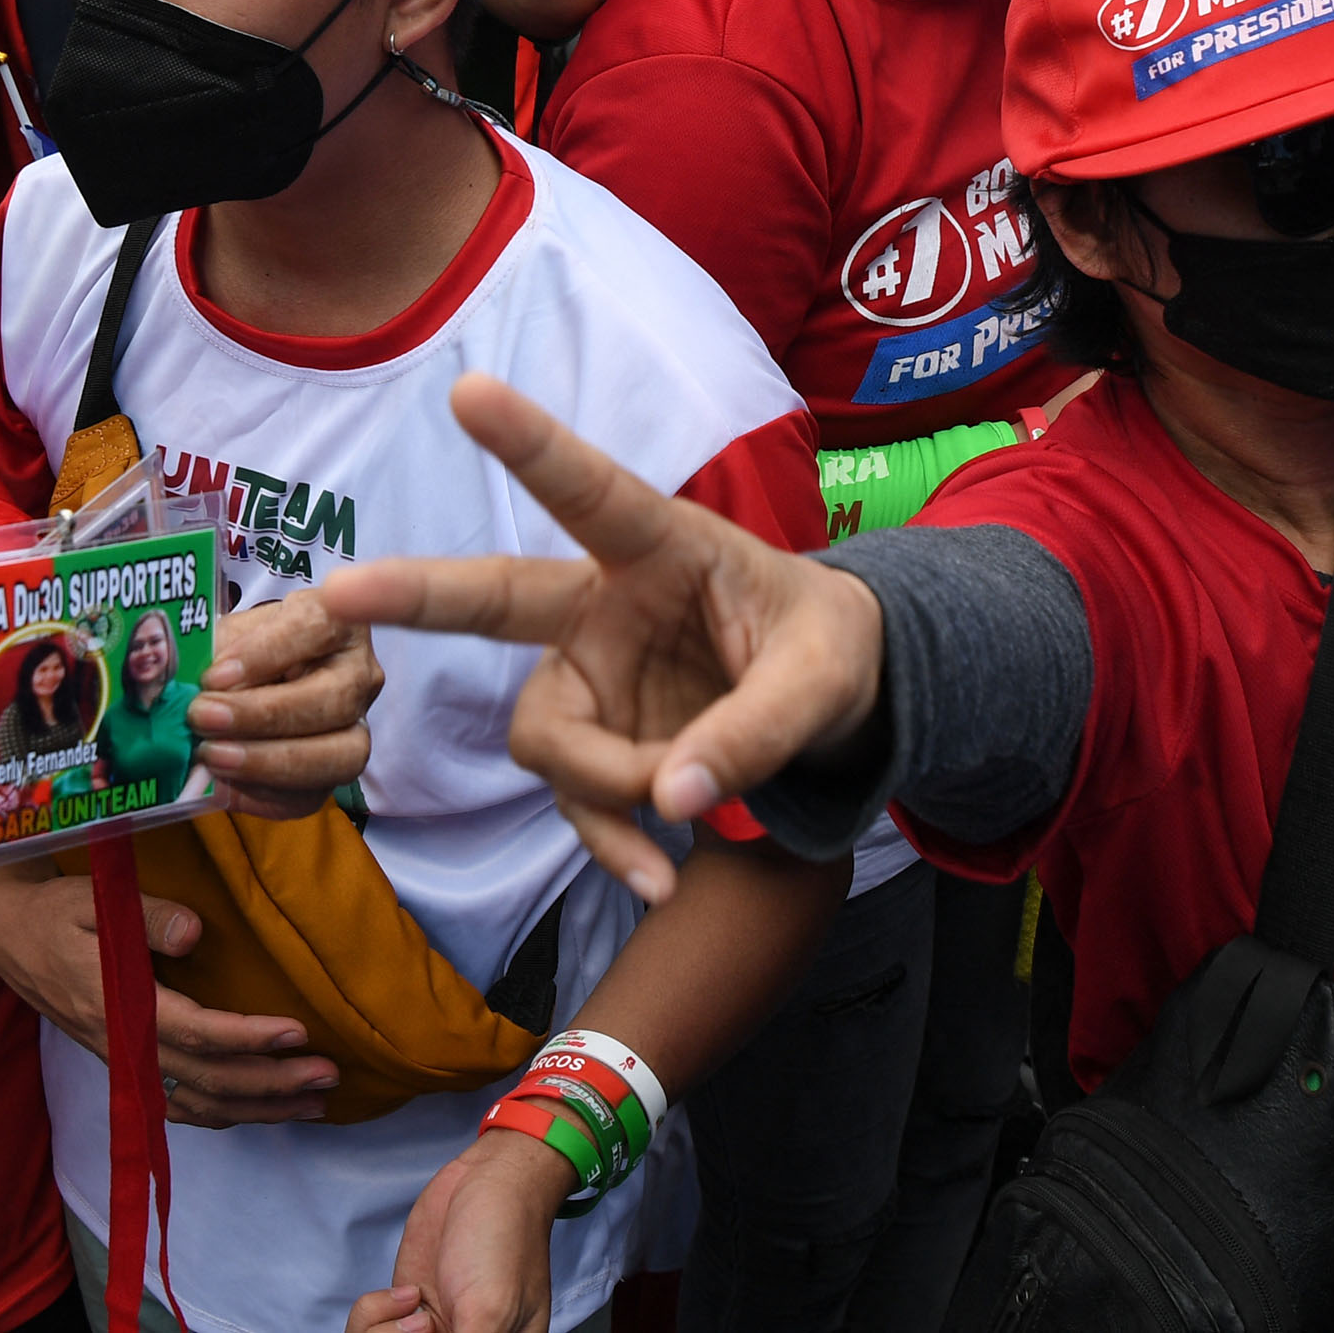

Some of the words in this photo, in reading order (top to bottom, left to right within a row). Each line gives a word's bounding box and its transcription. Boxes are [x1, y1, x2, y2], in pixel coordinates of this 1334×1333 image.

[1147, 50, 1186, 81] FOR
[888, 342, 962, 384] FOR
[13, 576, 64, 626] Du30
[68, 553, 197, 617] SUPPORTERS
[179, 595, 210, 635] #4
[26, 739, 98, 779] Fernandez
[57, 778, 158, 826] UNITEAM
